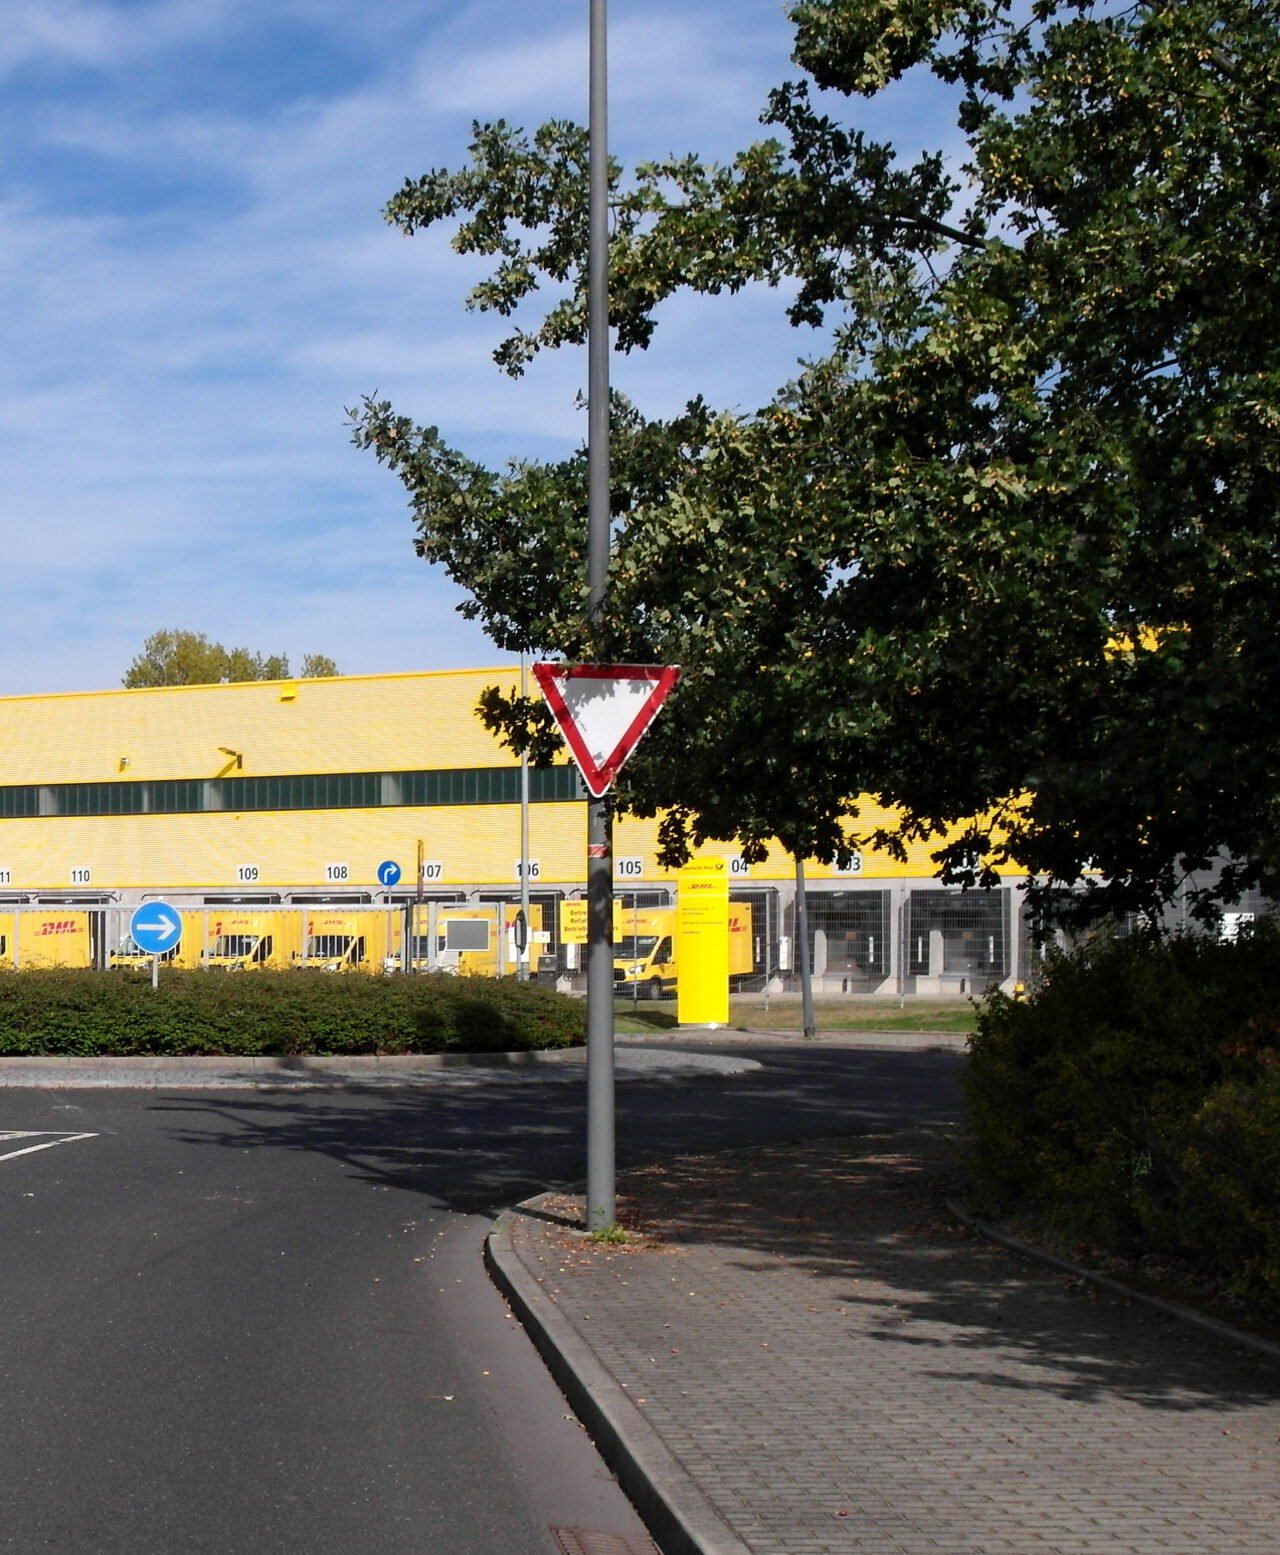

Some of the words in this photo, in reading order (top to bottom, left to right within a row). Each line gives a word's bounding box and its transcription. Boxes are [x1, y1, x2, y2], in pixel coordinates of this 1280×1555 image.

[327, 866, 348, 879] 108
[619, 861, 642, 875] 105
[732, 860, 748, 873] 04
[72, 870, 91, 882] 110
[238, 868, 259, 880] 109
[42, 920, 78, 935] DHL
